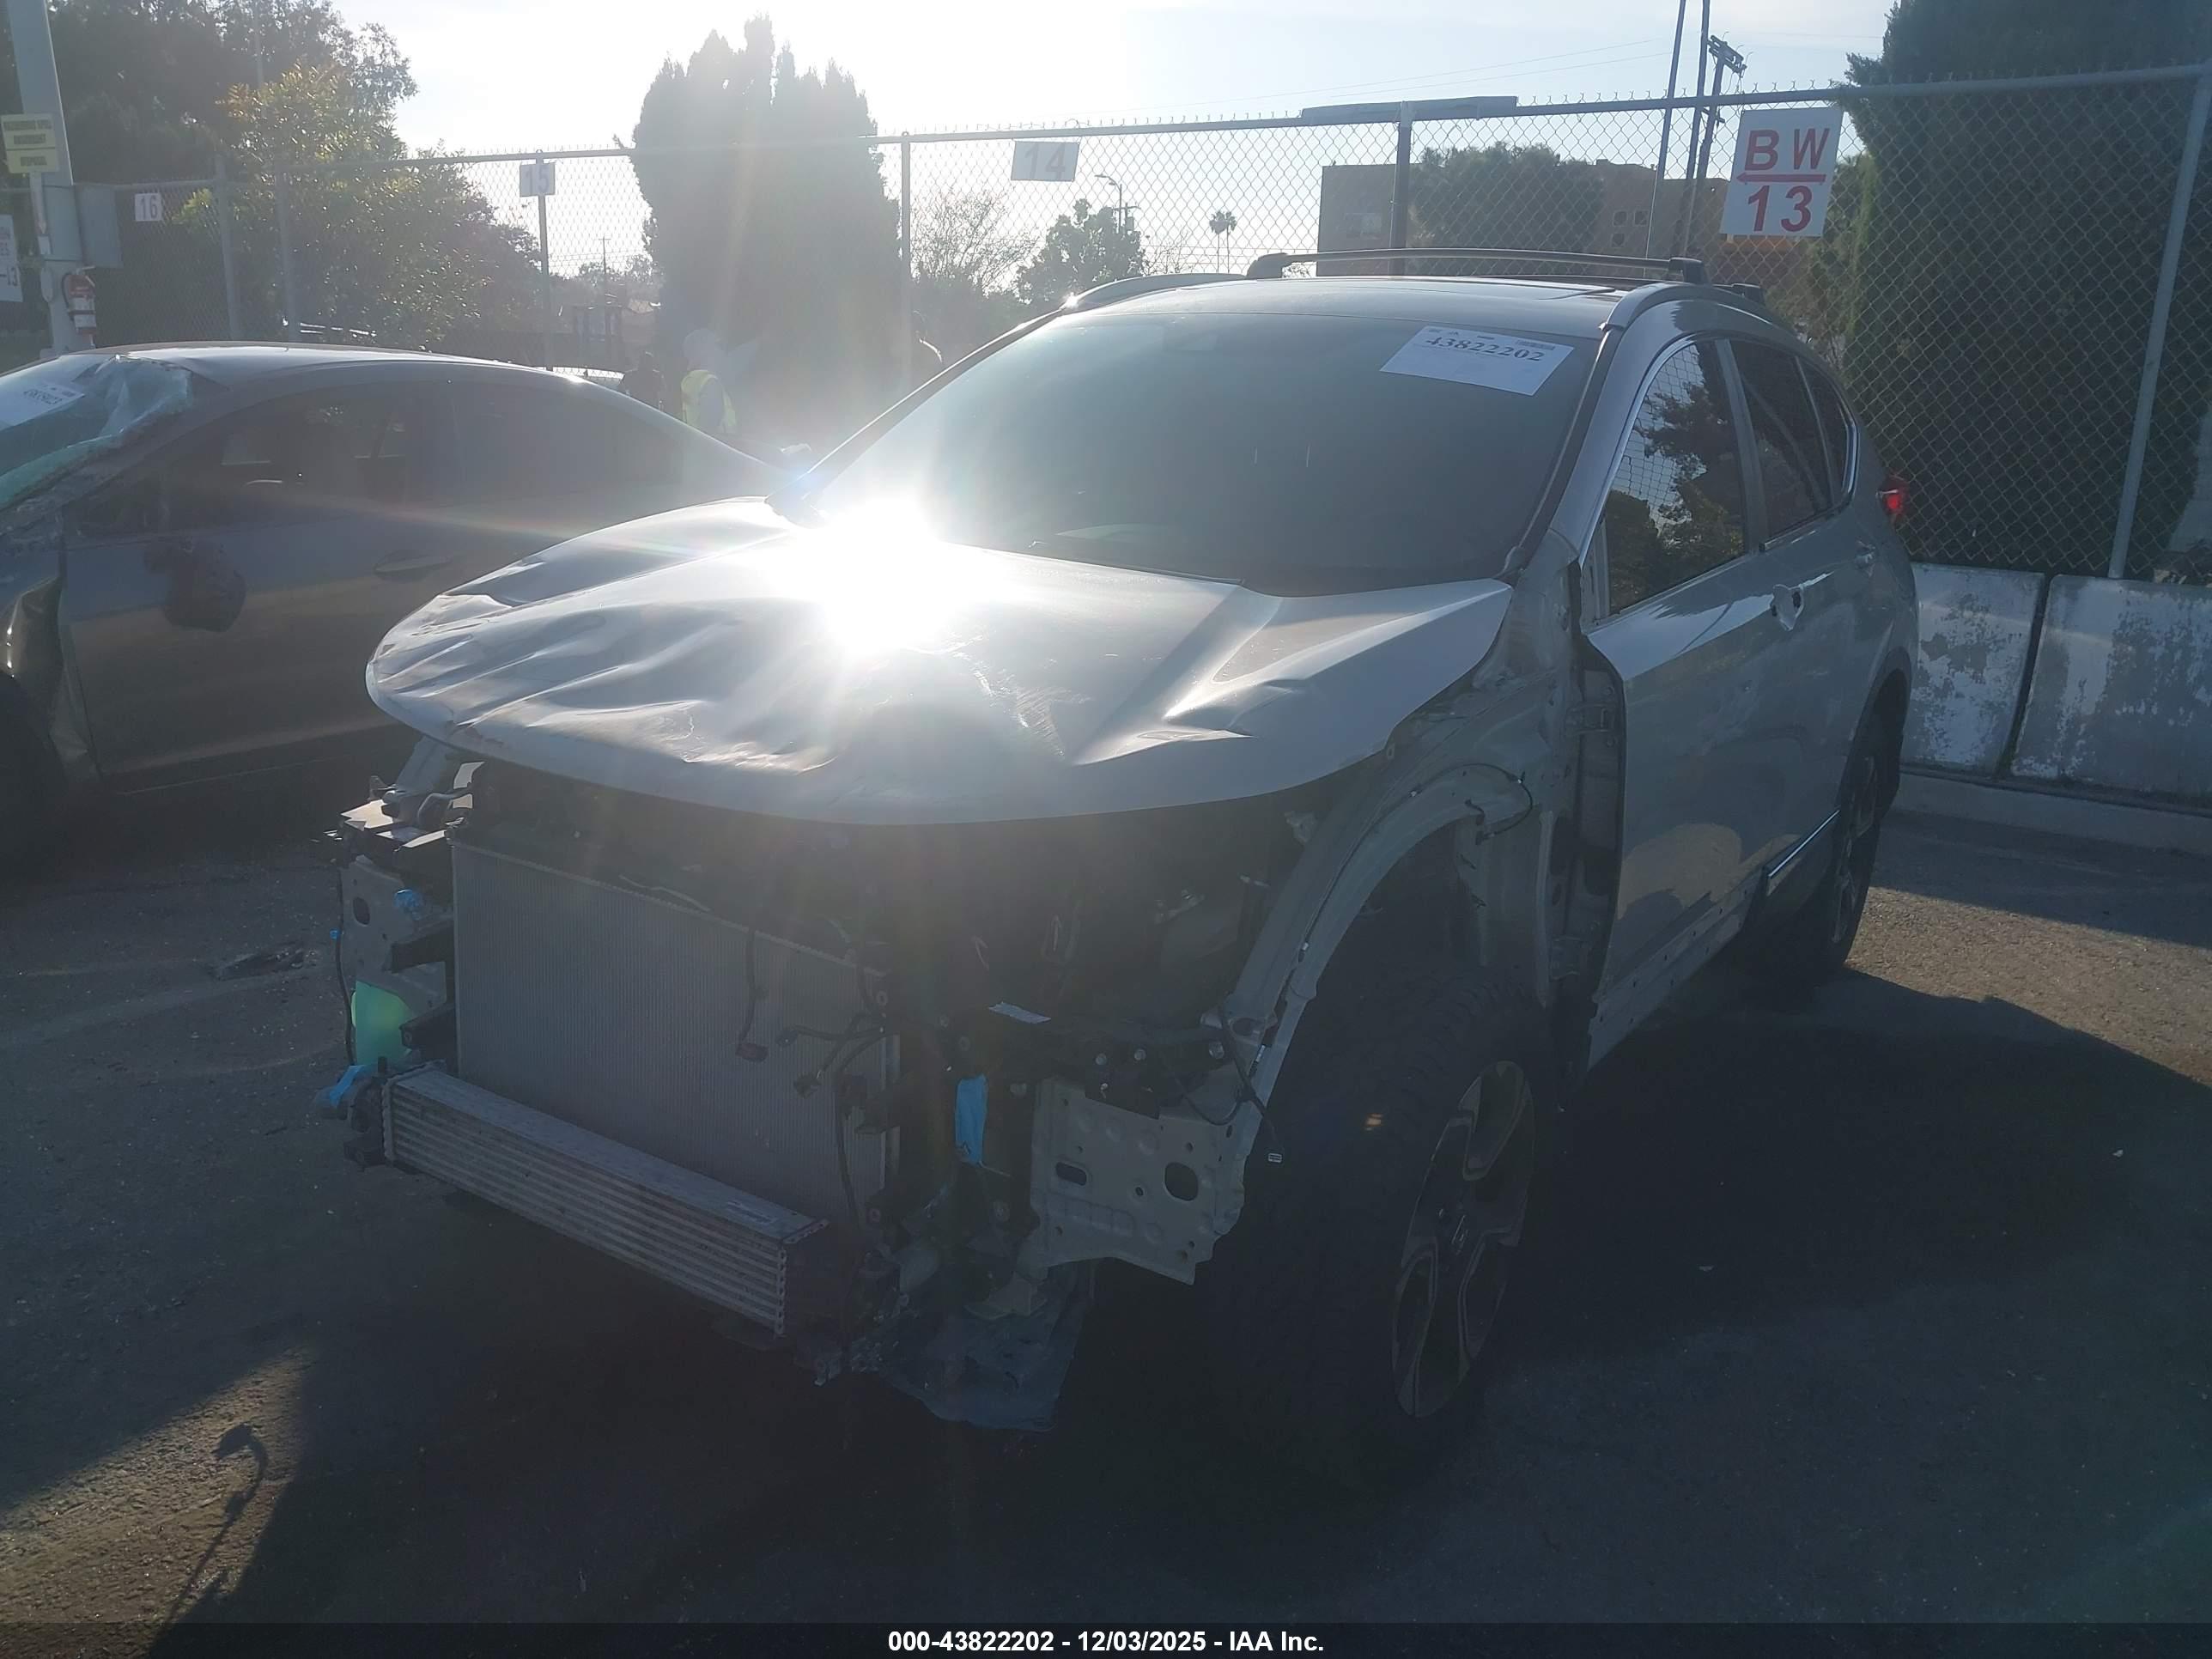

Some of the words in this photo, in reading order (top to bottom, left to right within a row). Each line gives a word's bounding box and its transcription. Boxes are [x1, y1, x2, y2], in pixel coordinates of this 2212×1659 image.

[1024, 142, 1066, 179] 14
[525, 164, 550, 195] 15
[139, 194, 158, 221] 16
[1747, 185, 1813, 233] 13
[1425, 336, 1546, 362] 43822202
